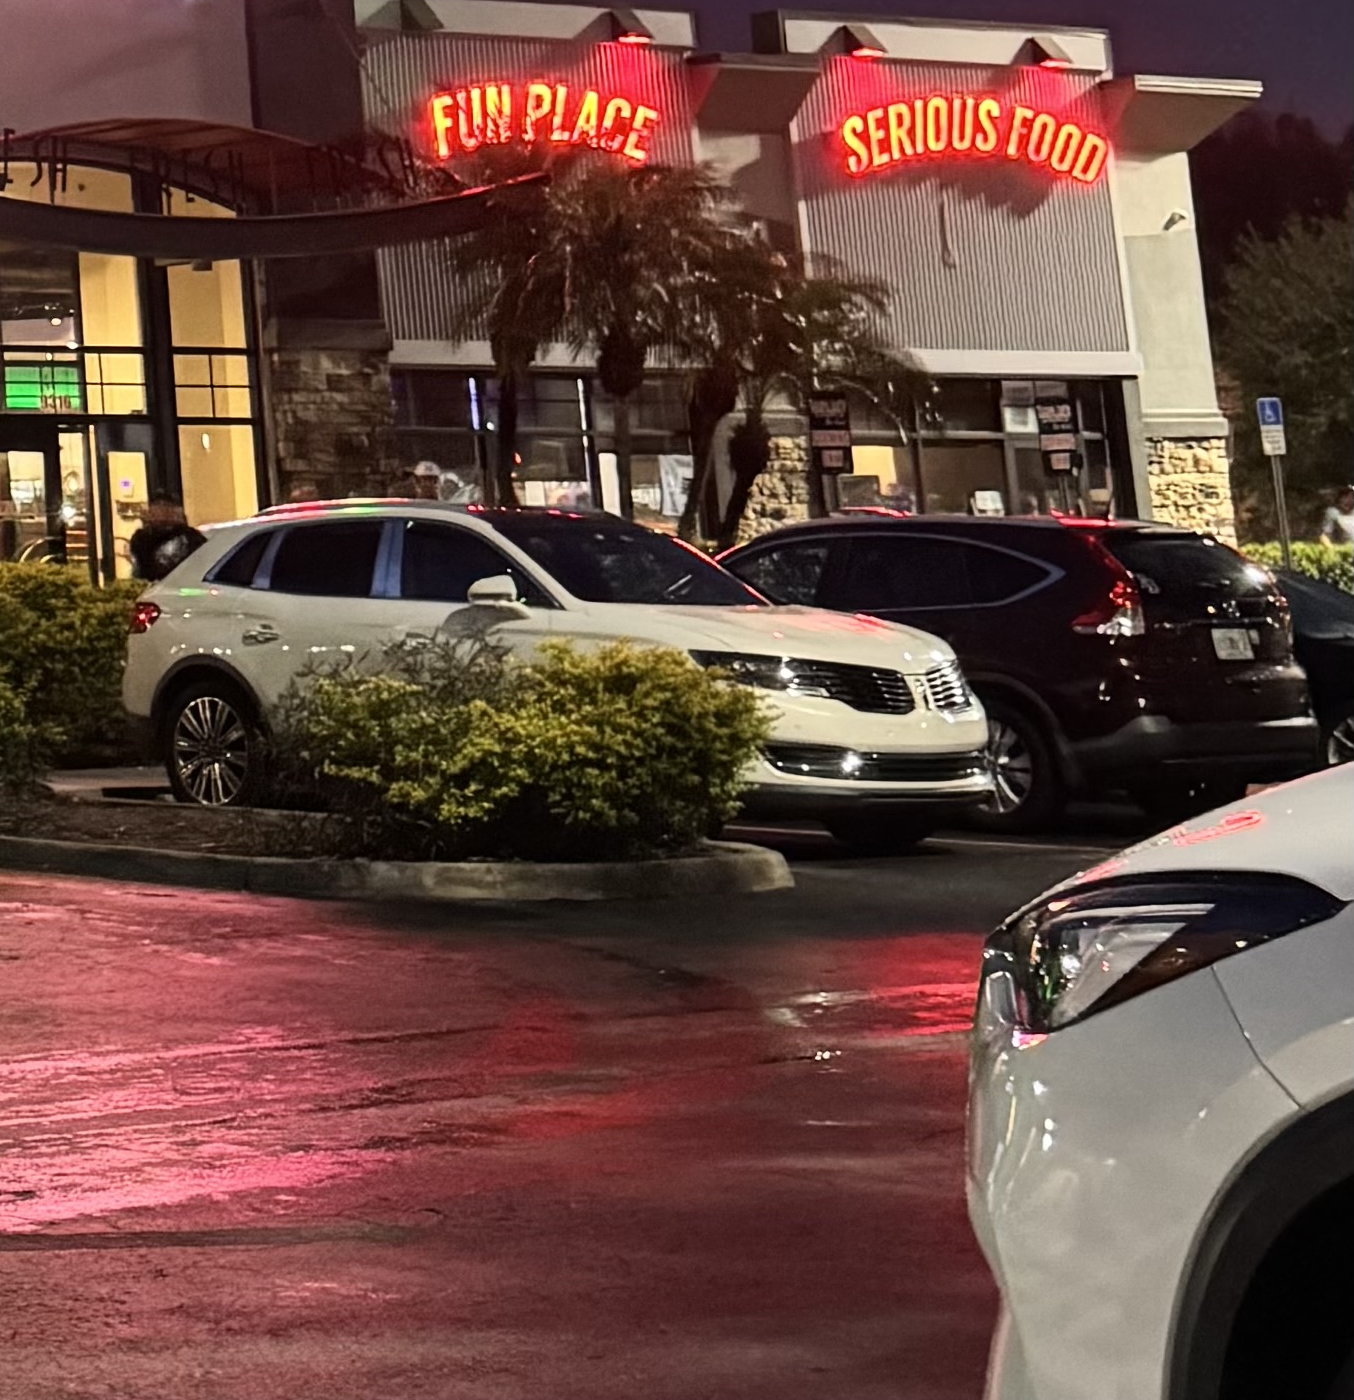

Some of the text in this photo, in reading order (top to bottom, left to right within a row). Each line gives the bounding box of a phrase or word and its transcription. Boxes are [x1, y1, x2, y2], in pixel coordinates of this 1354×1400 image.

[431, 83, 659, 162] FUN PLACE
[843, 95, 1107, 183] SERIOUS FOOD
